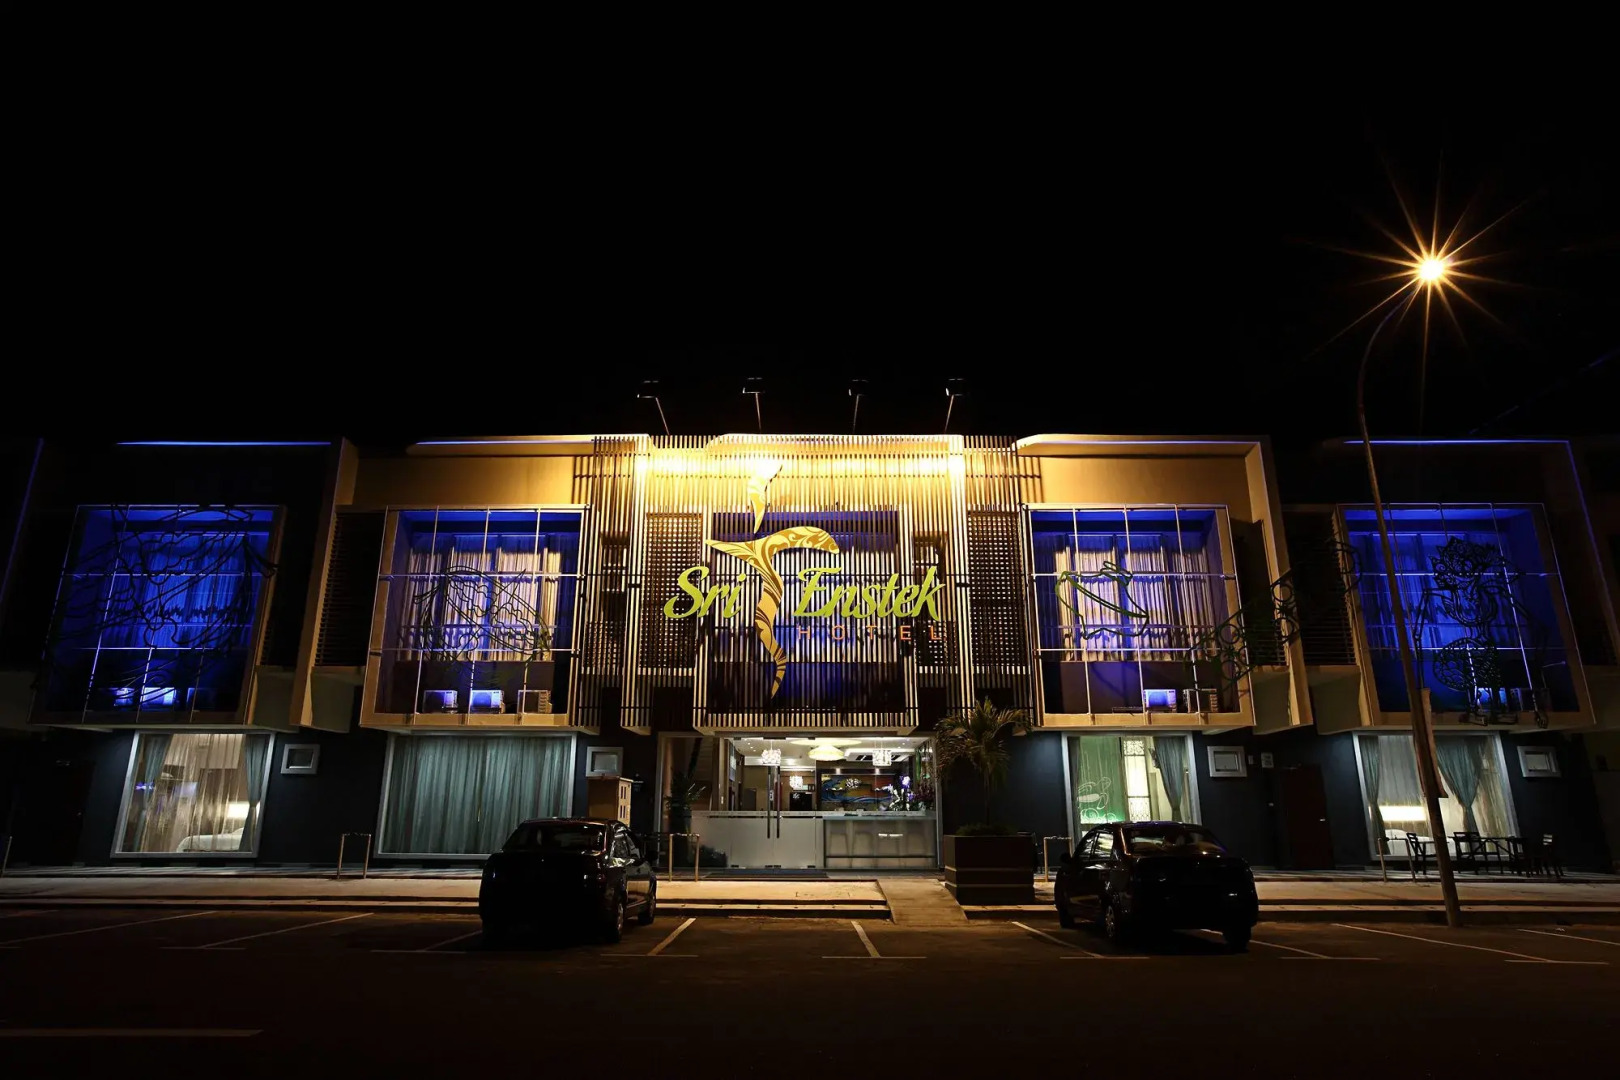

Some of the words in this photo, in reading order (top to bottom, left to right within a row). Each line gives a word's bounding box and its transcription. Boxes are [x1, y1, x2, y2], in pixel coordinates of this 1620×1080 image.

[664, 566, 746, 618] Sri
[793, 566, 946, 621] Enstek
[797, 625, 942, 641] HOTEL
